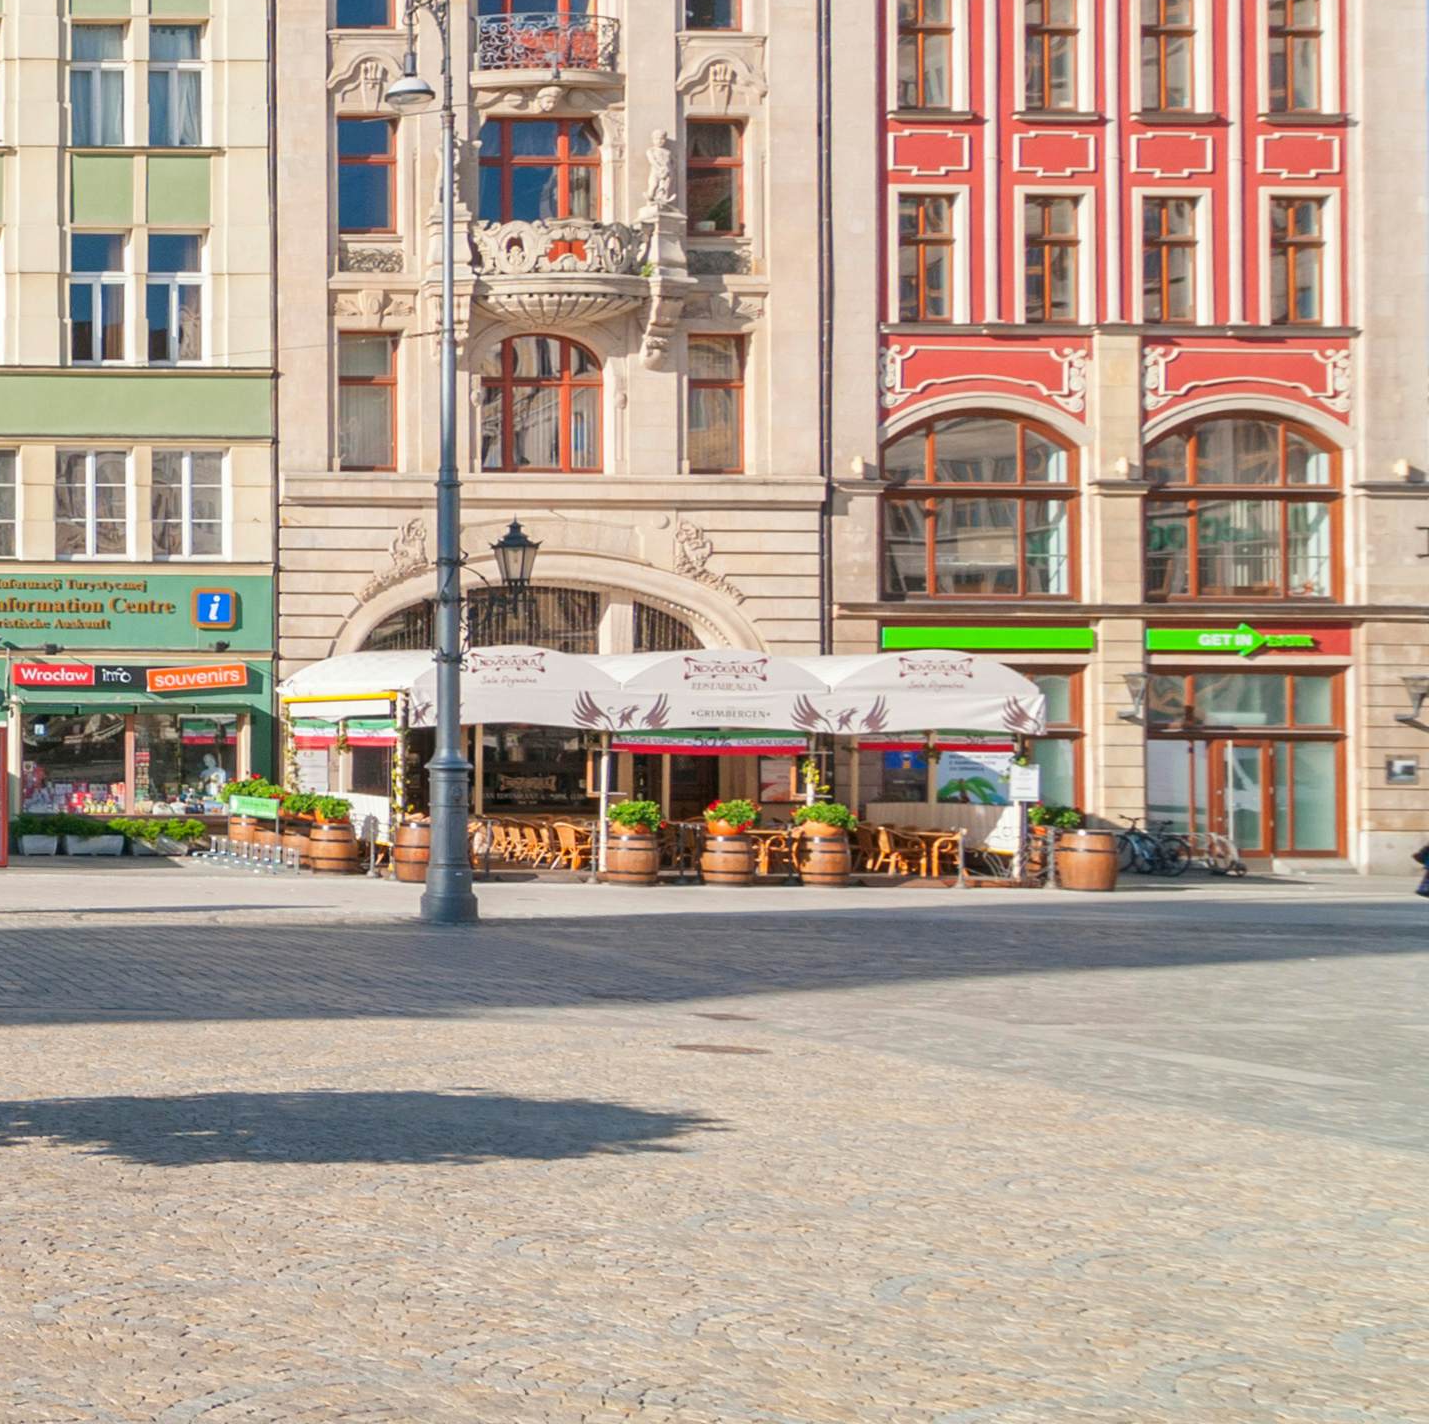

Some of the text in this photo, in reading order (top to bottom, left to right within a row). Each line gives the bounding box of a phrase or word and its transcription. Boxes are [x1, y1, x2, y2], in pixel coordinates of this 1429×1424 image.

[67, 579, 148, 593] Turystycznej
[109, 597, 177, 614] Centre
[54, 618, 112, 630] Auskunft
[1198, 634, 1232, 646] GET
[21, 667, 89, 682] Wrocław
[101, 667, 132, 683] info
[154, 668, 241, 688] souvenirs
